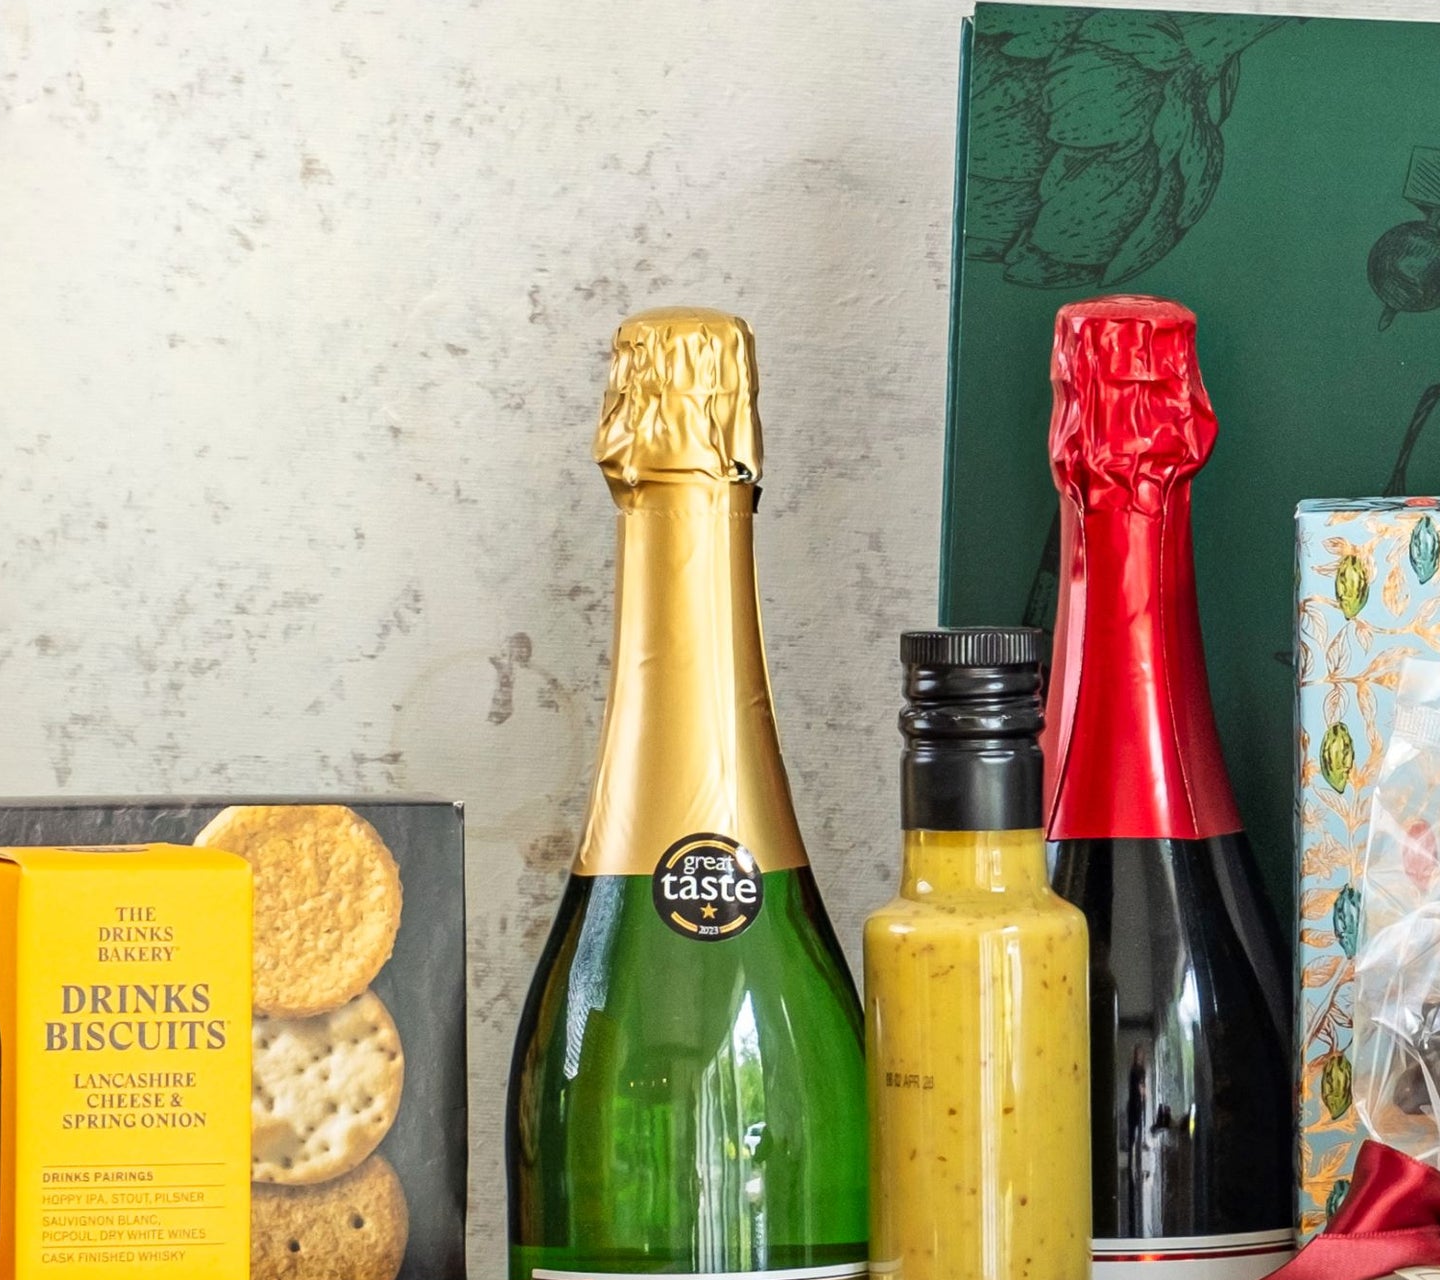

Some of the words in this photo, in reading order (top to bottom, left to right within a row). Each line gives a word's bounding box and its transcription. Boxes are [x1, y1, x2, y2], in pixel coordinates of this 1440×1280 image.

[684, 855, 734, 874] great
[661, 873, 757, 903] taste
[116, 907, 156, 921] THE
[99, 927, 174, 942] DRINKS
[699, 926, 719, 935] 2023
[98, 947, 175, 962] BAKERY
[62, 984, 210, 1014] DRINKS
[45, 1020, 226, 1051] BISCUITS
[74, 1073, 196, 1088] LANCASHIRE
[87, 1094, 165, 1108] CHEESE
[170, 1093, 182, 1107] &
[62, 1114, 136, 1129] SPRING
[141, 1113, 207, 1128] ONION
[42, 1172, 89, 1182] DRINKS
[94, 1172, 153, 1182] PAIRINGS
[155, 1192, 204, 1202] PILSNER
[42, 1216, 114, 1227] SAUVIGNON
